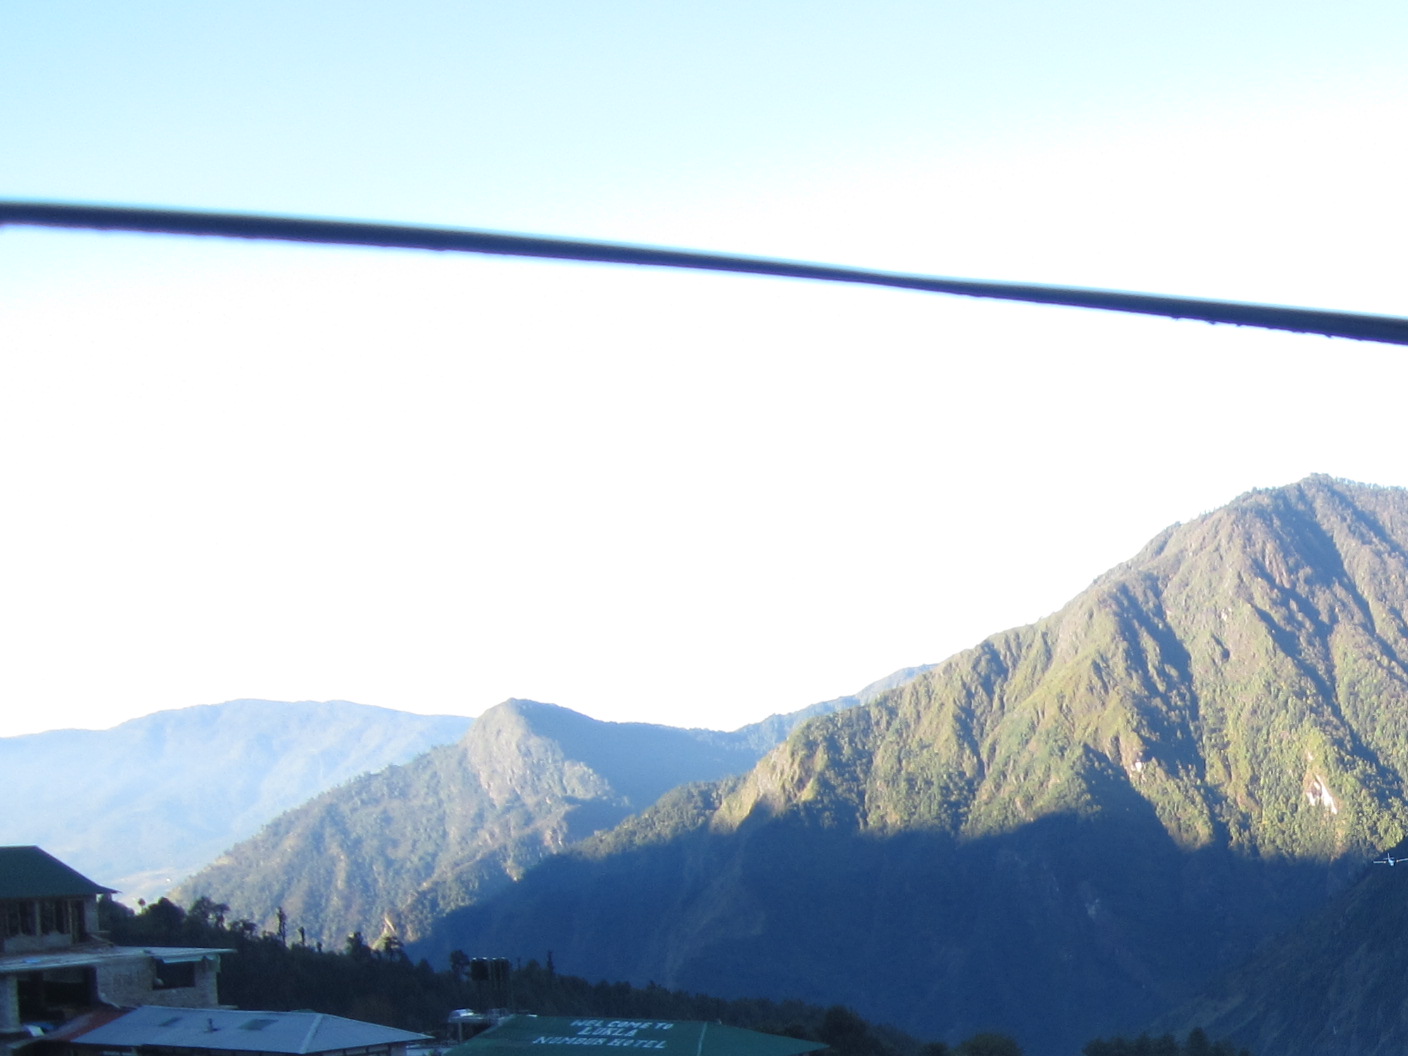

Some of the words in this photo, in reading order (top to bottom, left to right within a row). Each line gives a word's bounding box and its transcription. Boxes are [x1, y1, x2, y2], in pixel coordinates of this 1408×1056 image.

[577, 1026, 639, 1037] LUKLA
[653, 1022, 674, 1030] TO
[606, 1038, 668, 1049] HOTEL
